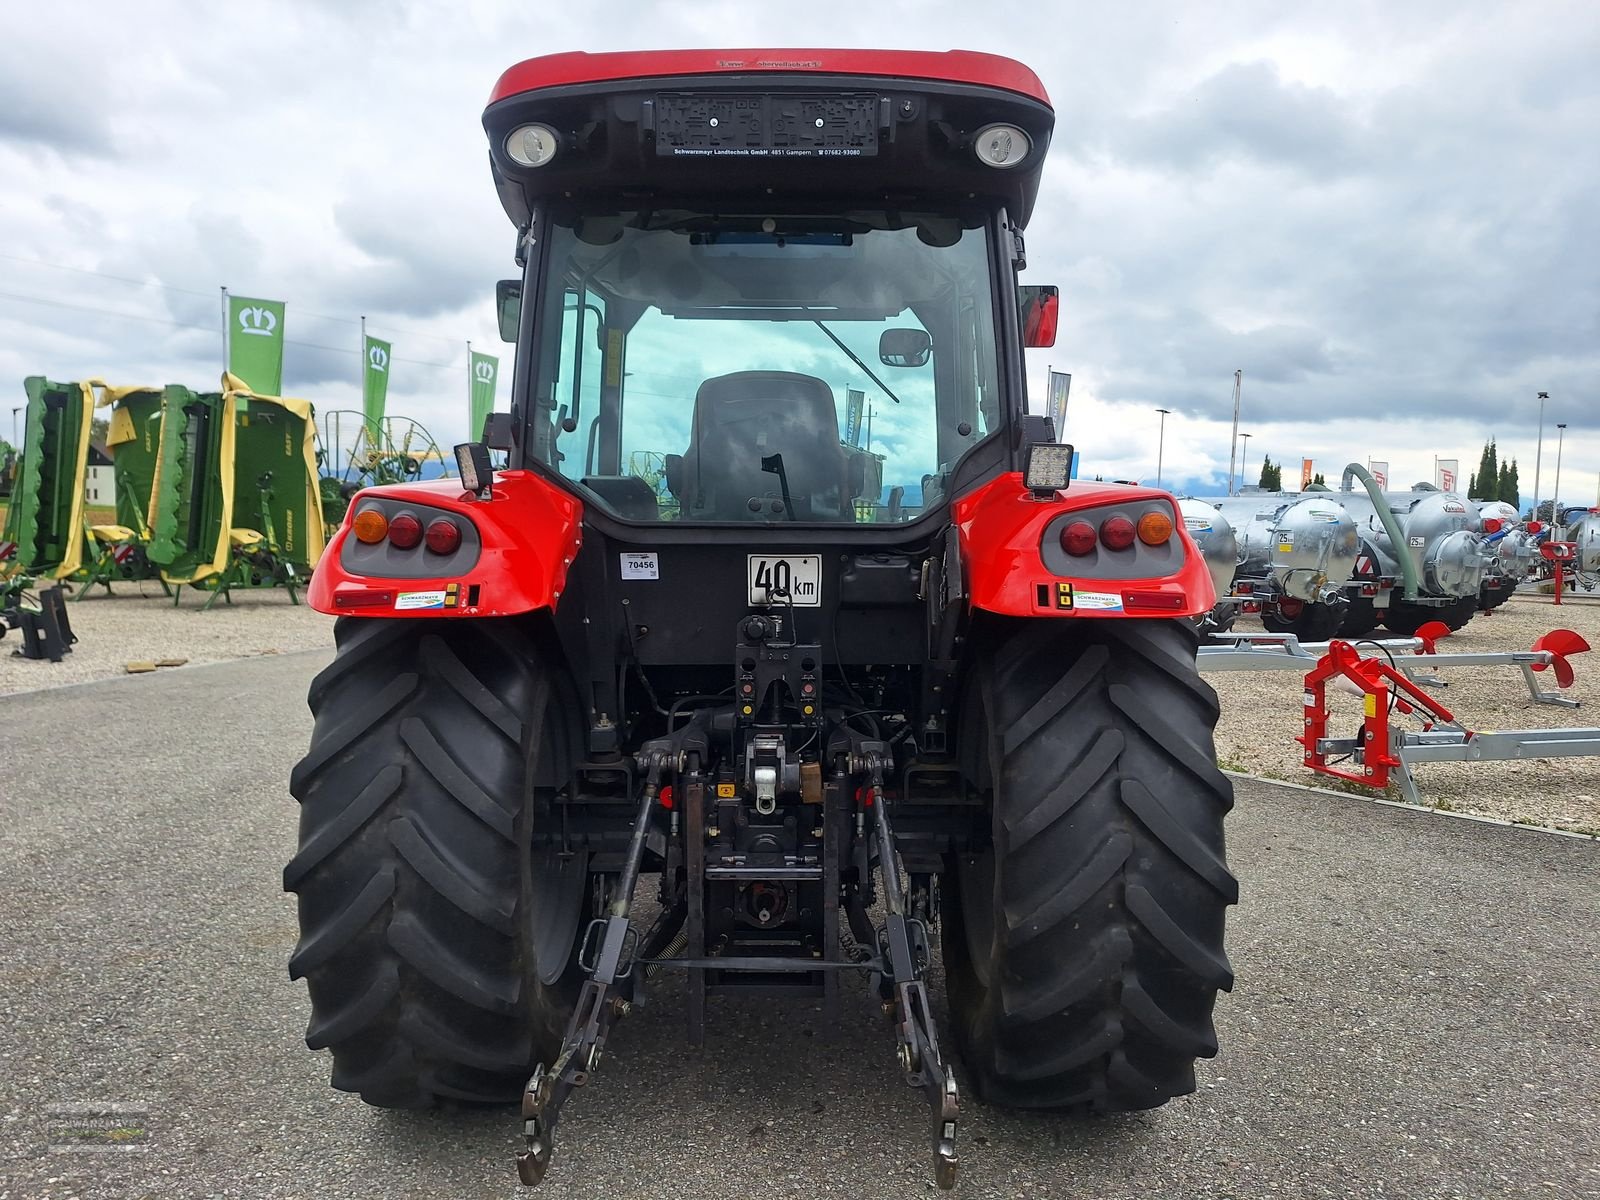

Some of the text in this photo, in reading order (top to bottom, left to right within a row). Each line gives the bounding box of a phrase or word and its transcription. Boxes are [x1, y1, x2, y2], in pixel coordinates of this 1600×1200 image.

[674, 148, 713, 156] Schwarzmayr
[285, 433, 293, 456] EASY
[1279, 533, 1288, 543] 25
[1411, 537, 1419, 546] 25
[628, 561, 655, 569] 70456
[755, 560, 814, 597] 40 km
